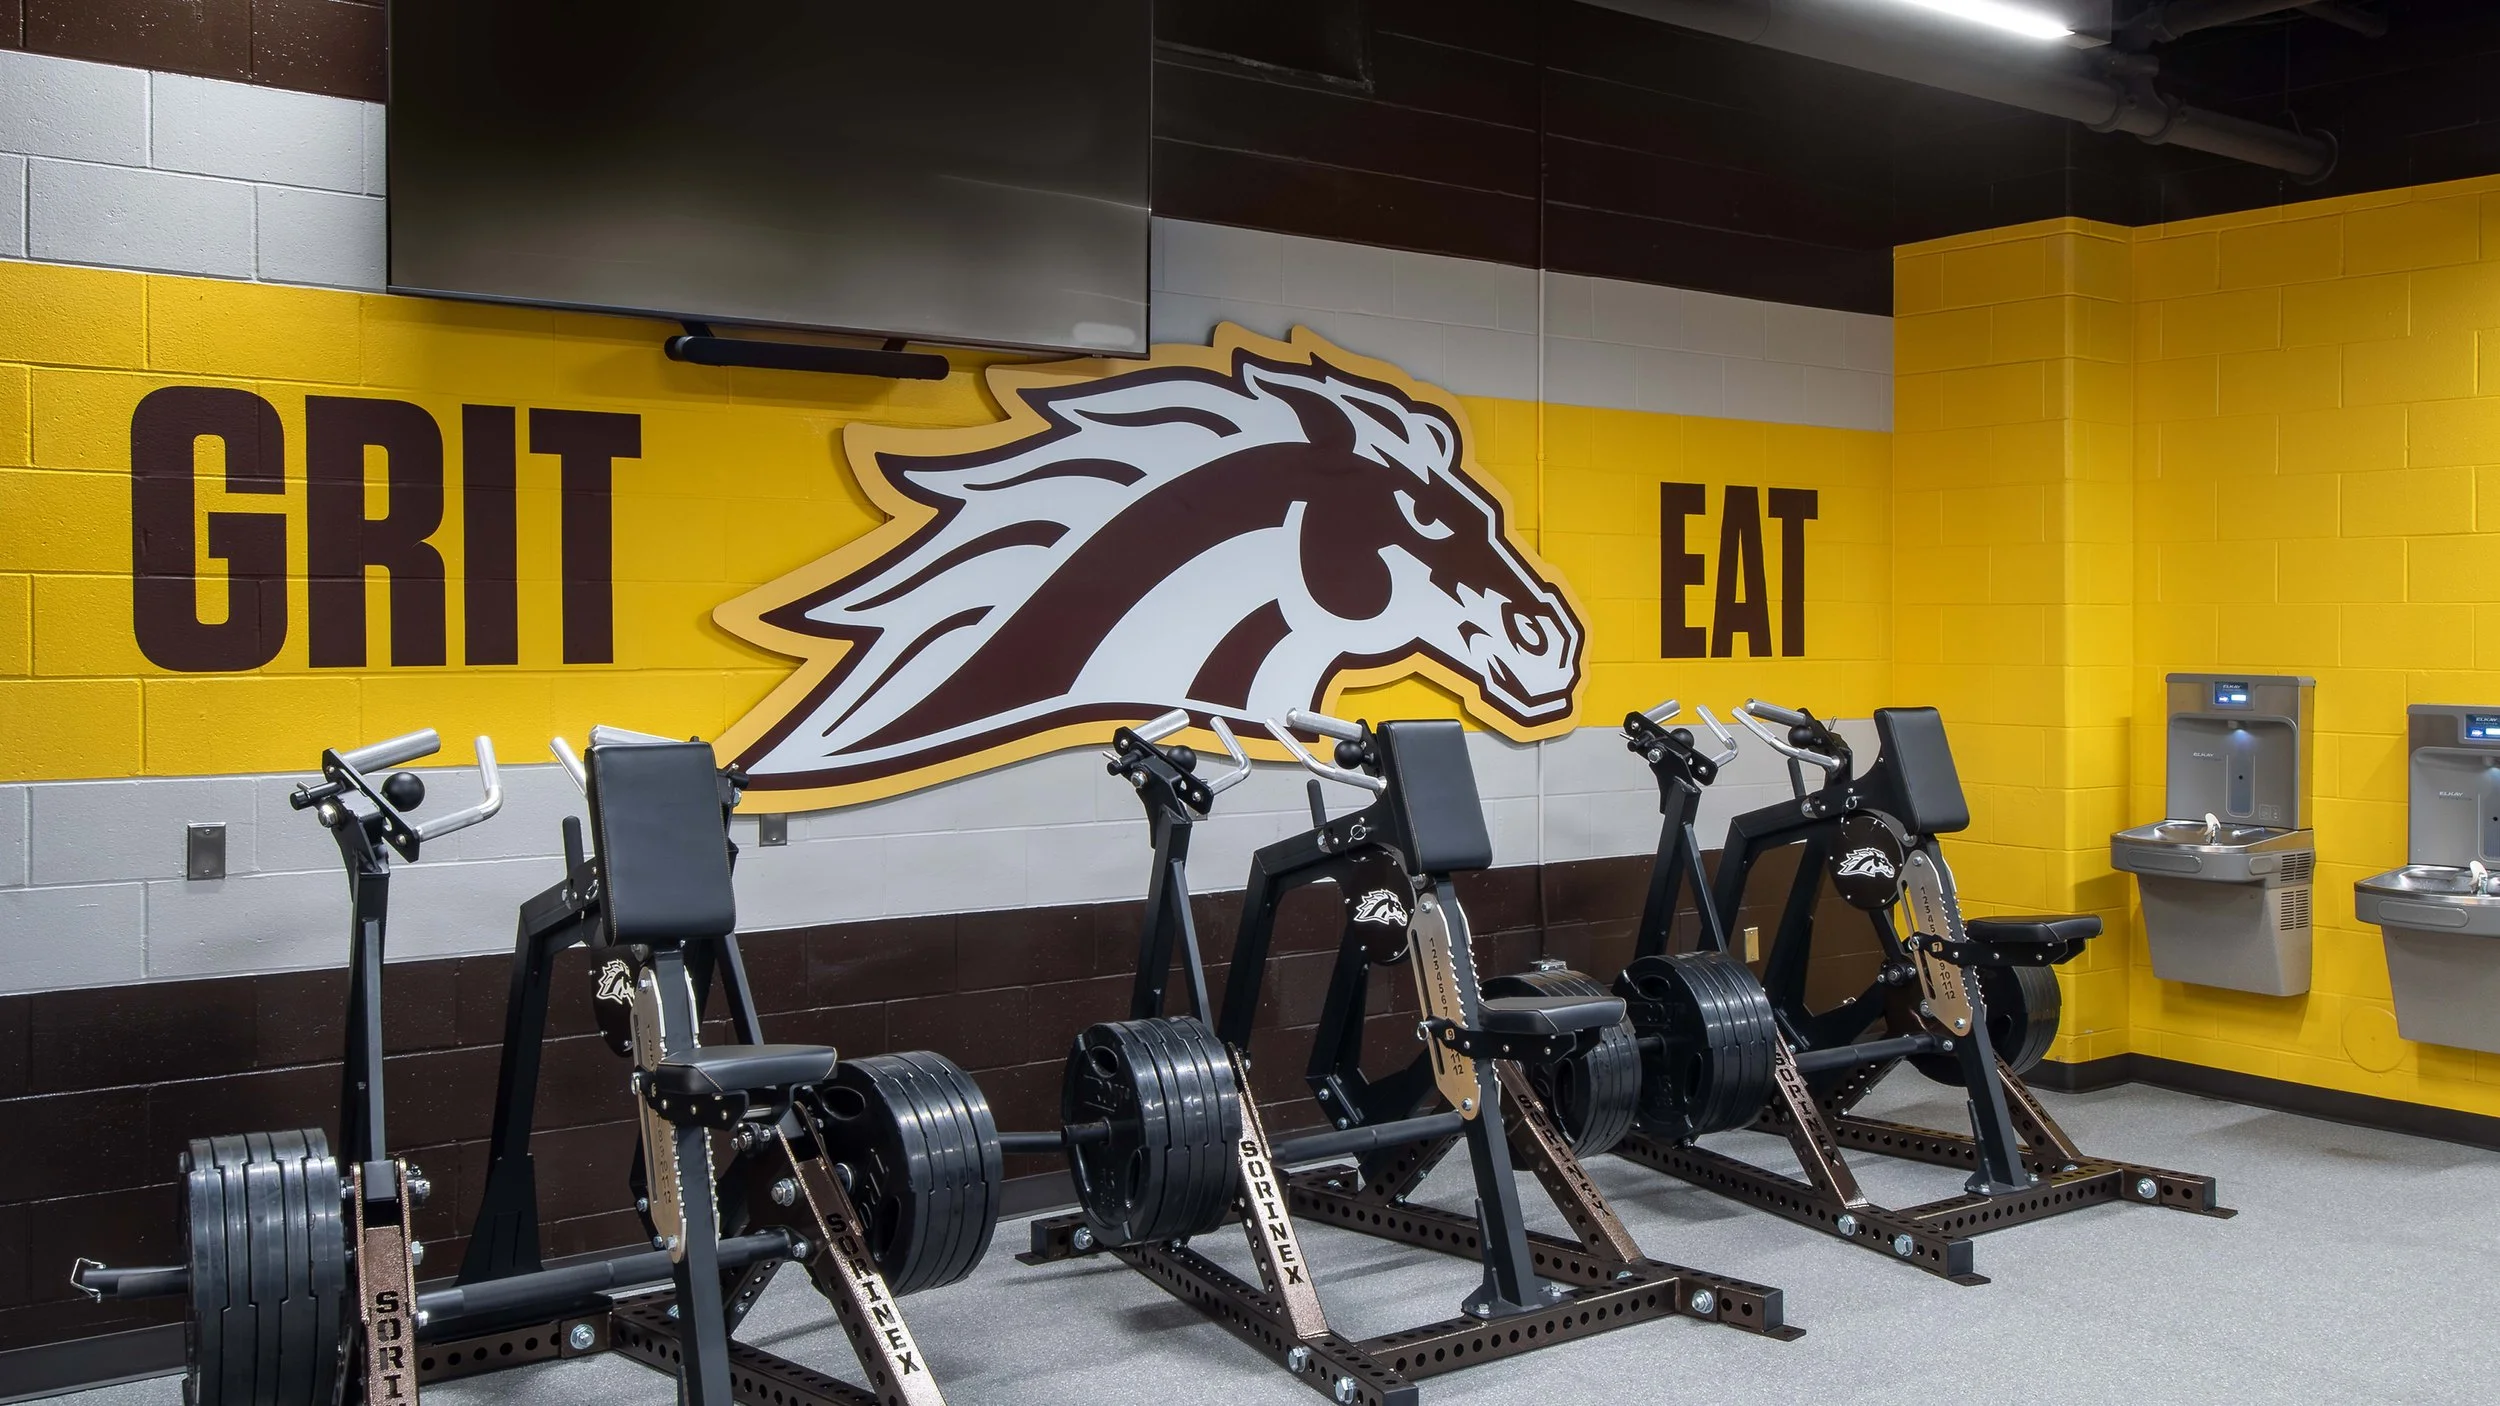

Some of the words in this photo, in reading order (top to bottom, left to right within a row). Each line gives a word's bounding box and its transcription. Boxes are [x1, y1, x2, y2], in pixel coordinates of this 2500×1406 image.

[130, 385, 641, 672] GRIT
[1660, 481, 1818, 659] EAT
[1922, 896, 1929, 904] 2
[1924, 905, 1931, 914] 3
[1927, 914, 1934, 923] 4
[1929, 924, 1936, 933] 5
[1429, 937, 1435, 947] 1
[1431, 949, 1438, 959] 2
[1433, 960, 1440, 970] 3
[1939, 962, 1946, 971] 9
[1436, 971, 1443, 981] 4
[1940, 971, 1951, 980] 10
[1438, 983, 1444, 993] 5
[1942, 981, 1953, 990] 11
[1440, 995, 1447, 1005] 6
[1944, 990, 1956, 1000] 12
[1443, 1006, 1448, 1017] 7
[1447, 1029, 1454, 1039] 9
[1450, 1053, 1461, 1063] 11
[1452, 1064, 1464, 1076] 12
[1517, 1094, 1611, 1219] SORINEX
[1240, 1140, 1305, 1285] SORINEX
[825, 1212, 921, 1376] SORINEX
[375, 1290, 407, 1406] SORI
